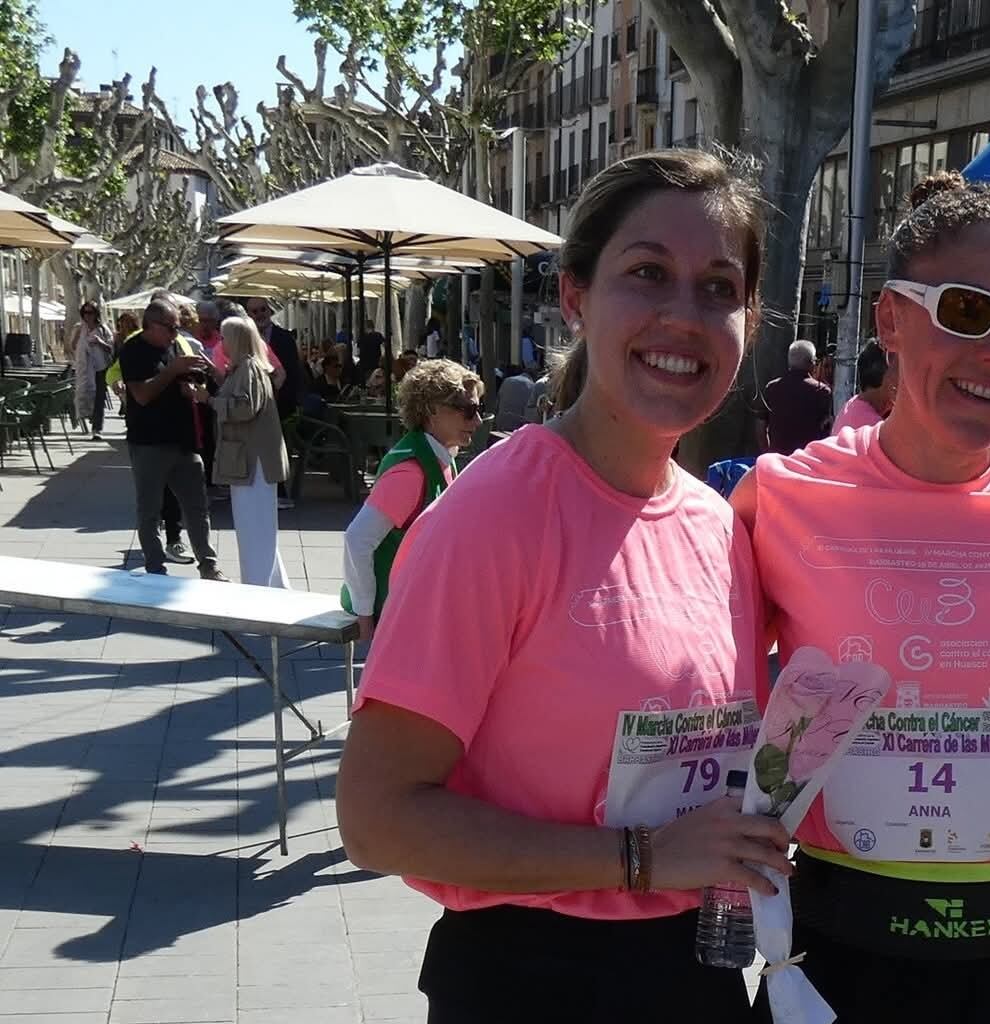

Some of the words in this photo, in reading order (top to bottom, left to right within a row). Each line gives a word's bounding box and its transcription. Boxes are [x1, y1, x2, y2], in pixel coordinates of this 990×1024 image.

[622, 713, 634, 736] IV
[636, 714, 673, 736] Marcha
[675, 712, 705, 735] Contra
[705, 709, 714, 729] el
[887, 713, 925, 732] Contra
[928, 713, 939, 732] el
[941, 711, 980, 732] Cáncer
[667, 735, 679, 756] XI
[680, 731, 711, 755] Carrera
[713, 729, 725, 749] de
[726, 728, 741, 747] las
[882, 732, 895, 751] XI
[896, 732, 941, 753] Carrera
[943, 733, 958, 753] de
[961, 733, 977, 753] las
[680, 757, 720, 793] 79
[908, 761, 957, 793] 14
[908, 805, 951, 817] ANNA
